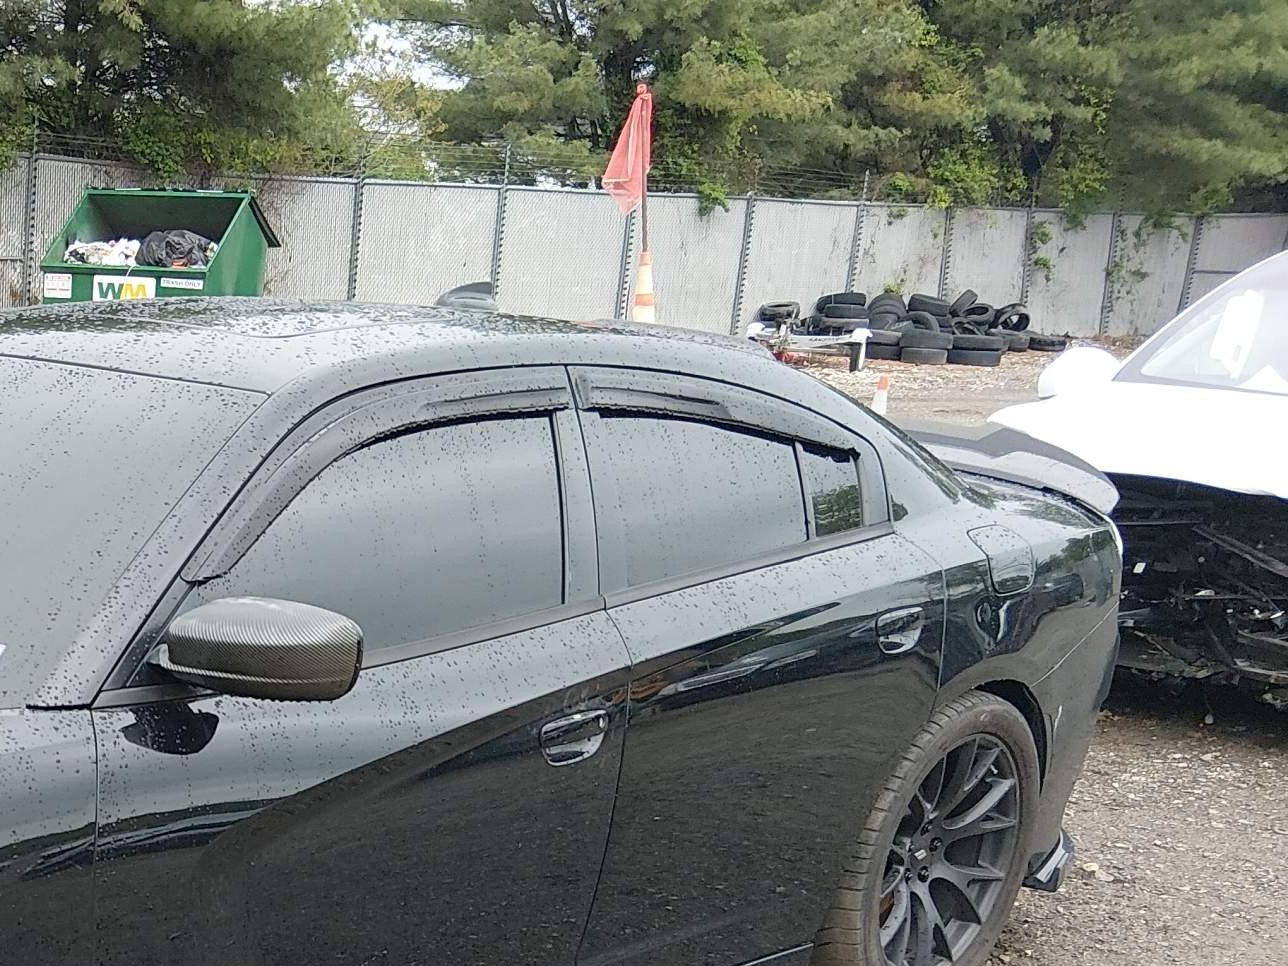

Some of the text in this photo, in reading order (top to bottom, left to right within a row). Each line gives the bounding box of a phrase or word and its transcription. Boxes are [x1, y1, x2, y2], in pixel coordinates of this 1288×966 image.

[97, 281, 147, 300] WM
[162, 279, 201, 289] TRASH ONLY
